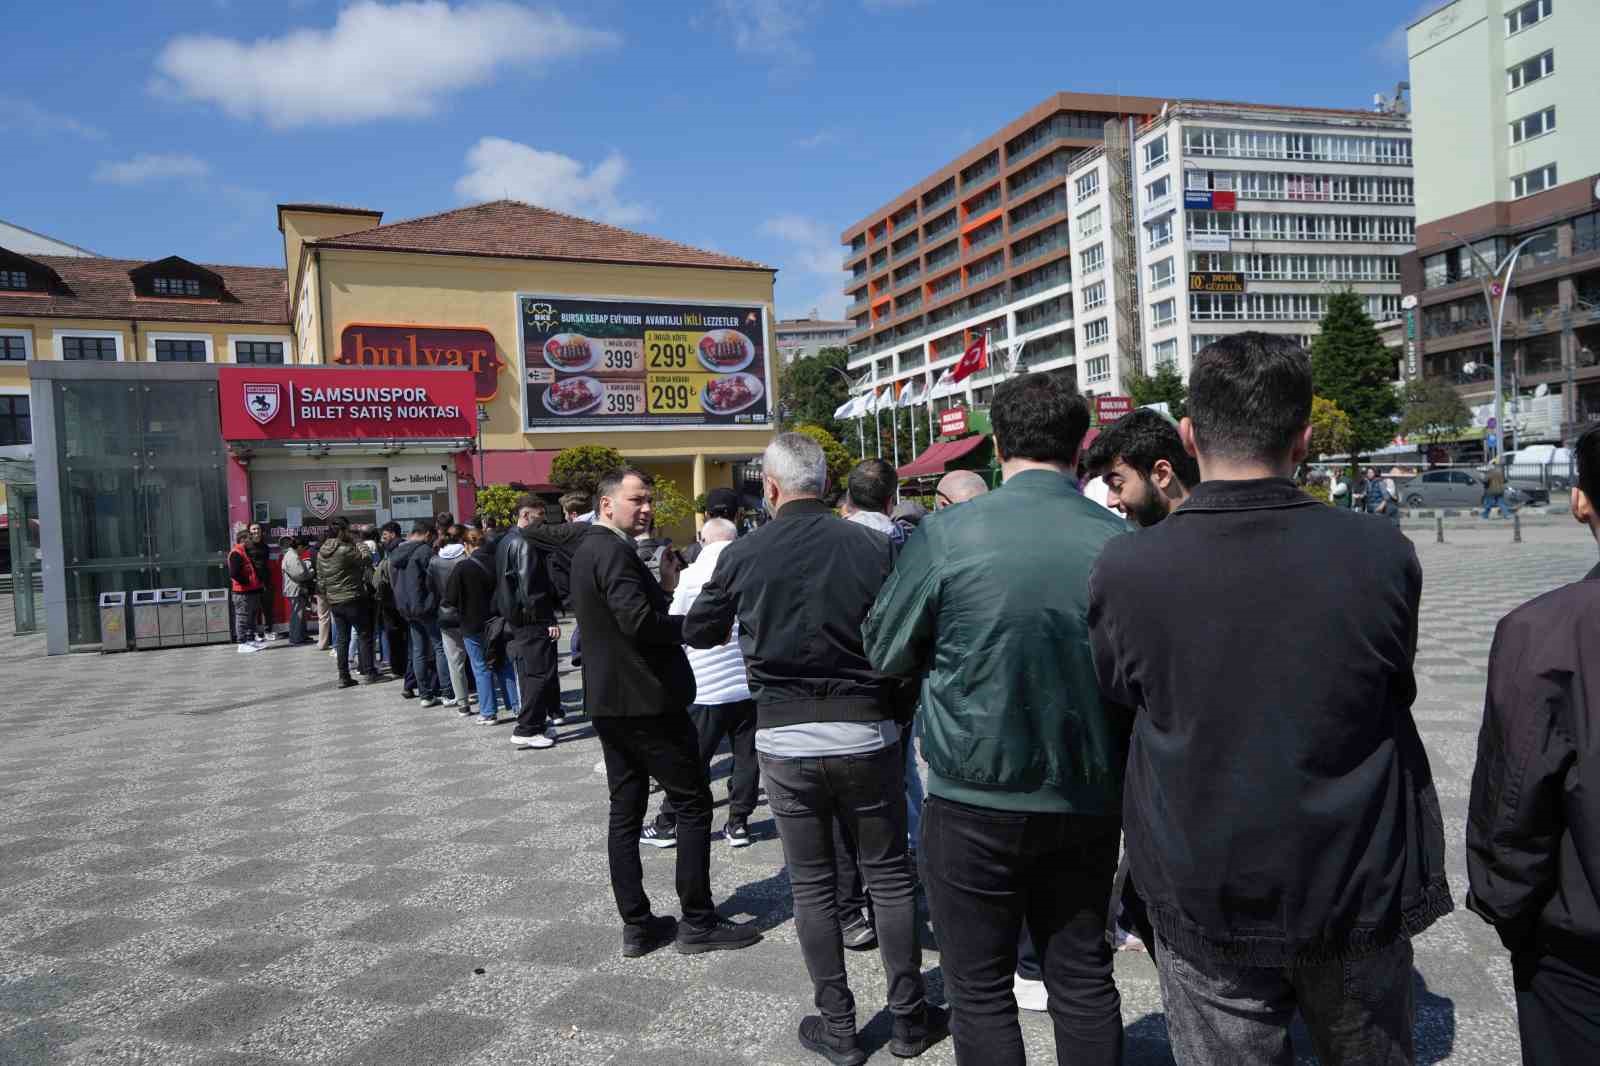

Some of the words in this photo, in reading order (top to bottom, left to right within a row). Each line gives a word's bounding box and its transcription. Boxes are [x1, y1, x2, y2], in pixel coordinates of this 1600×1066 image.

[561, 312, 584, 323] BURSA
[585, 313, 608, 325] KEBAP
[645, 315, 682, 326] AVANTAJLI
[703, 316, 739, 327] LEZZETLER
[351, 332, 487, 373] bulvar
[301, 388, 427, 402] SAMSUNSPOR
[350, 405, 393, 421] SATIŞ
[397, 405, 459, 418] NOKTASI
